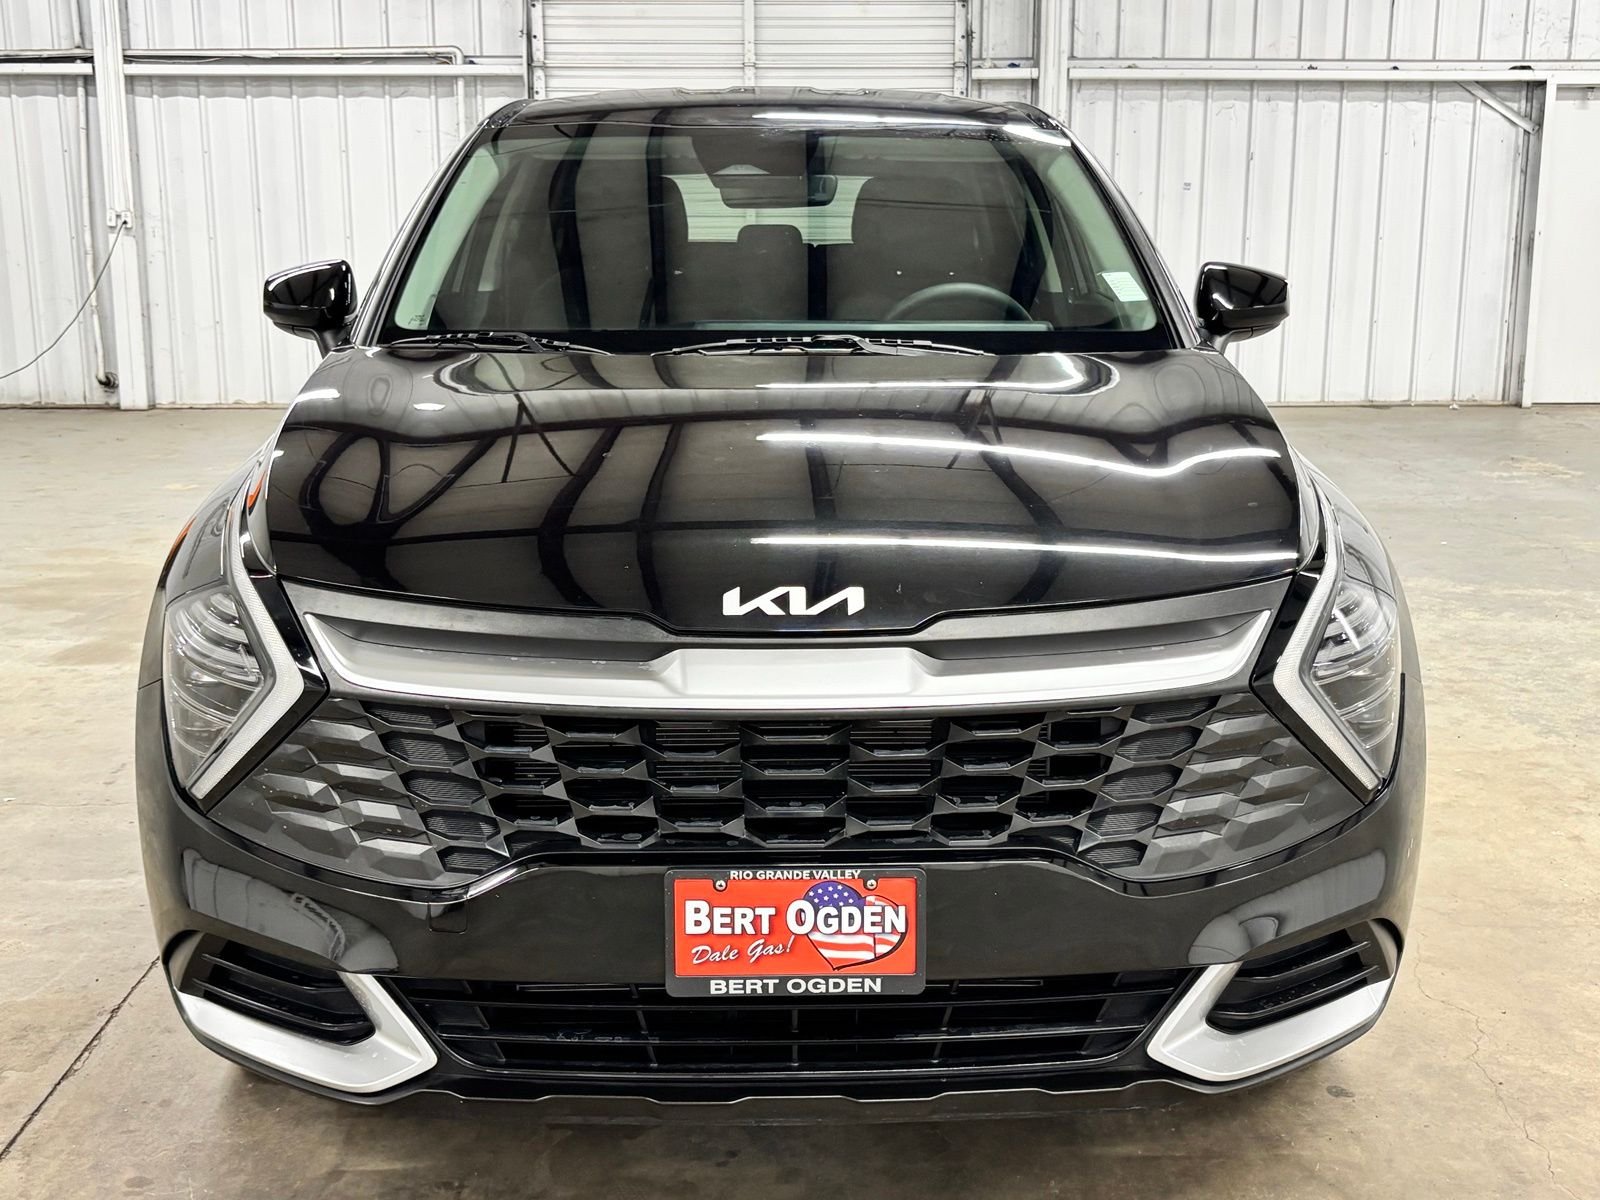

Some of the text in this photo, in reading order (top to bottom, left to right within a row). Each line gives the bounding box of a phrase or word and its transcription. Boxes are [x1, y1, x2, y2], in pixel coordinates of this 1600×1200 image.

[722, 586, 865, 616] KIA
[730, 869, 861, 880] RIO GRANDE VALLEY
[691, 934, 795, 965] Dale Gas!
[709, 978, 882, 995] BERT OGDEN
